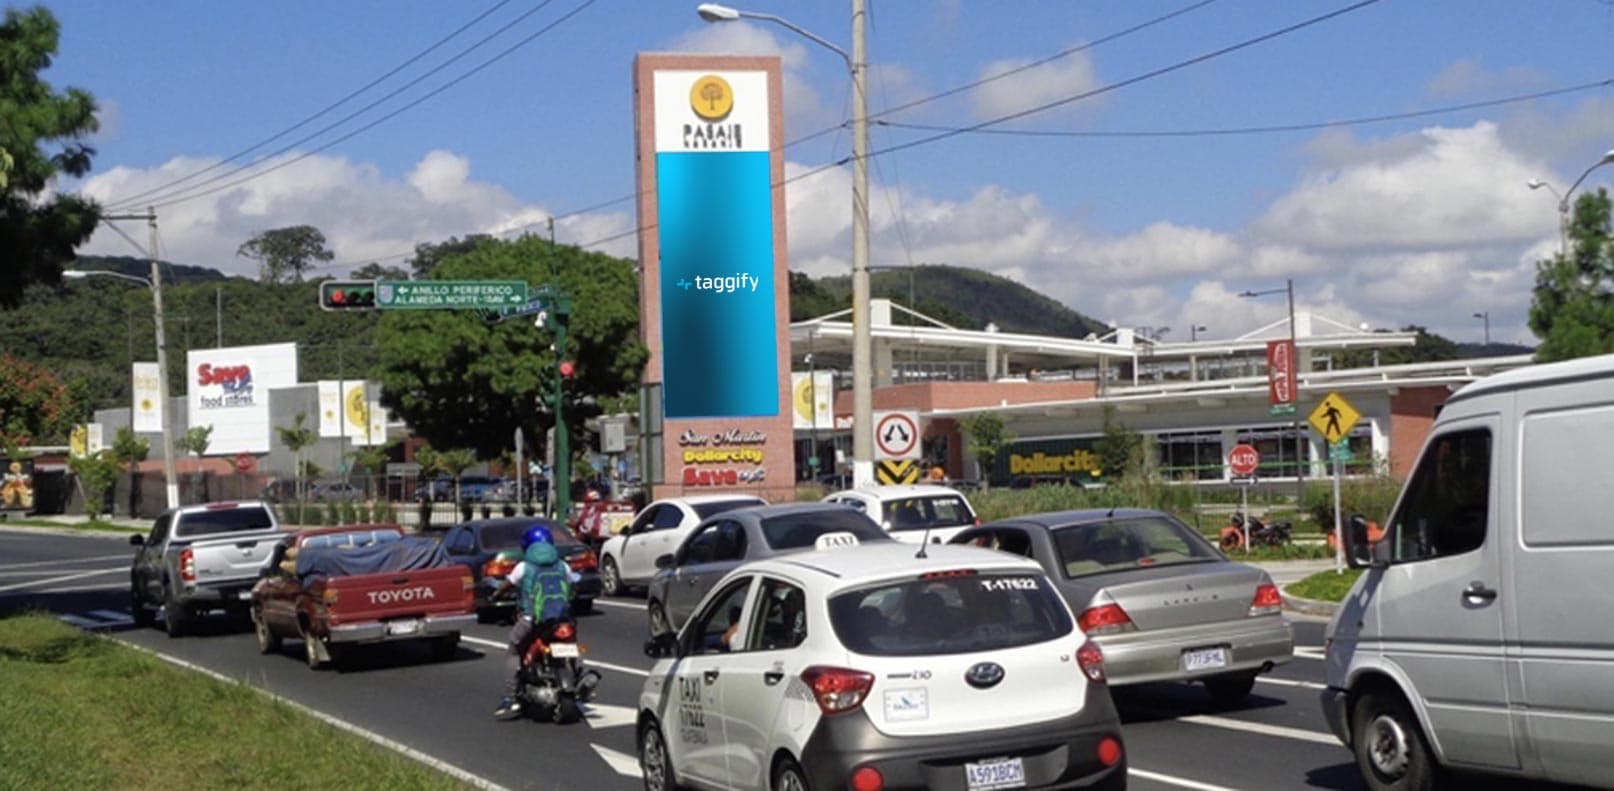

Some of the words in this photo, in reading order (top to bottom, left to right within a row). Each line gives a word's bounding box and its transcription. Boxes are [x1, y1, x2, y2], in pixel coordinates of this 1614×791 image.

[412, 286, 449, 295] ANILLO
[453, 286, 514, 295] PERIFERICO
[695, 272, 759, 293] taggify
[394, 295, 443, 304] ALAMEDA
[683, 448, 763, 465] Dollarcity
[1231, 453, 1257, 466] ALTO
[683, 467, 738, 486] Save
[824, 536, 854, 547] TAXI
[367, 586, 435, 604] TOYOTA
[679, 676, 701, 702] TAXI
